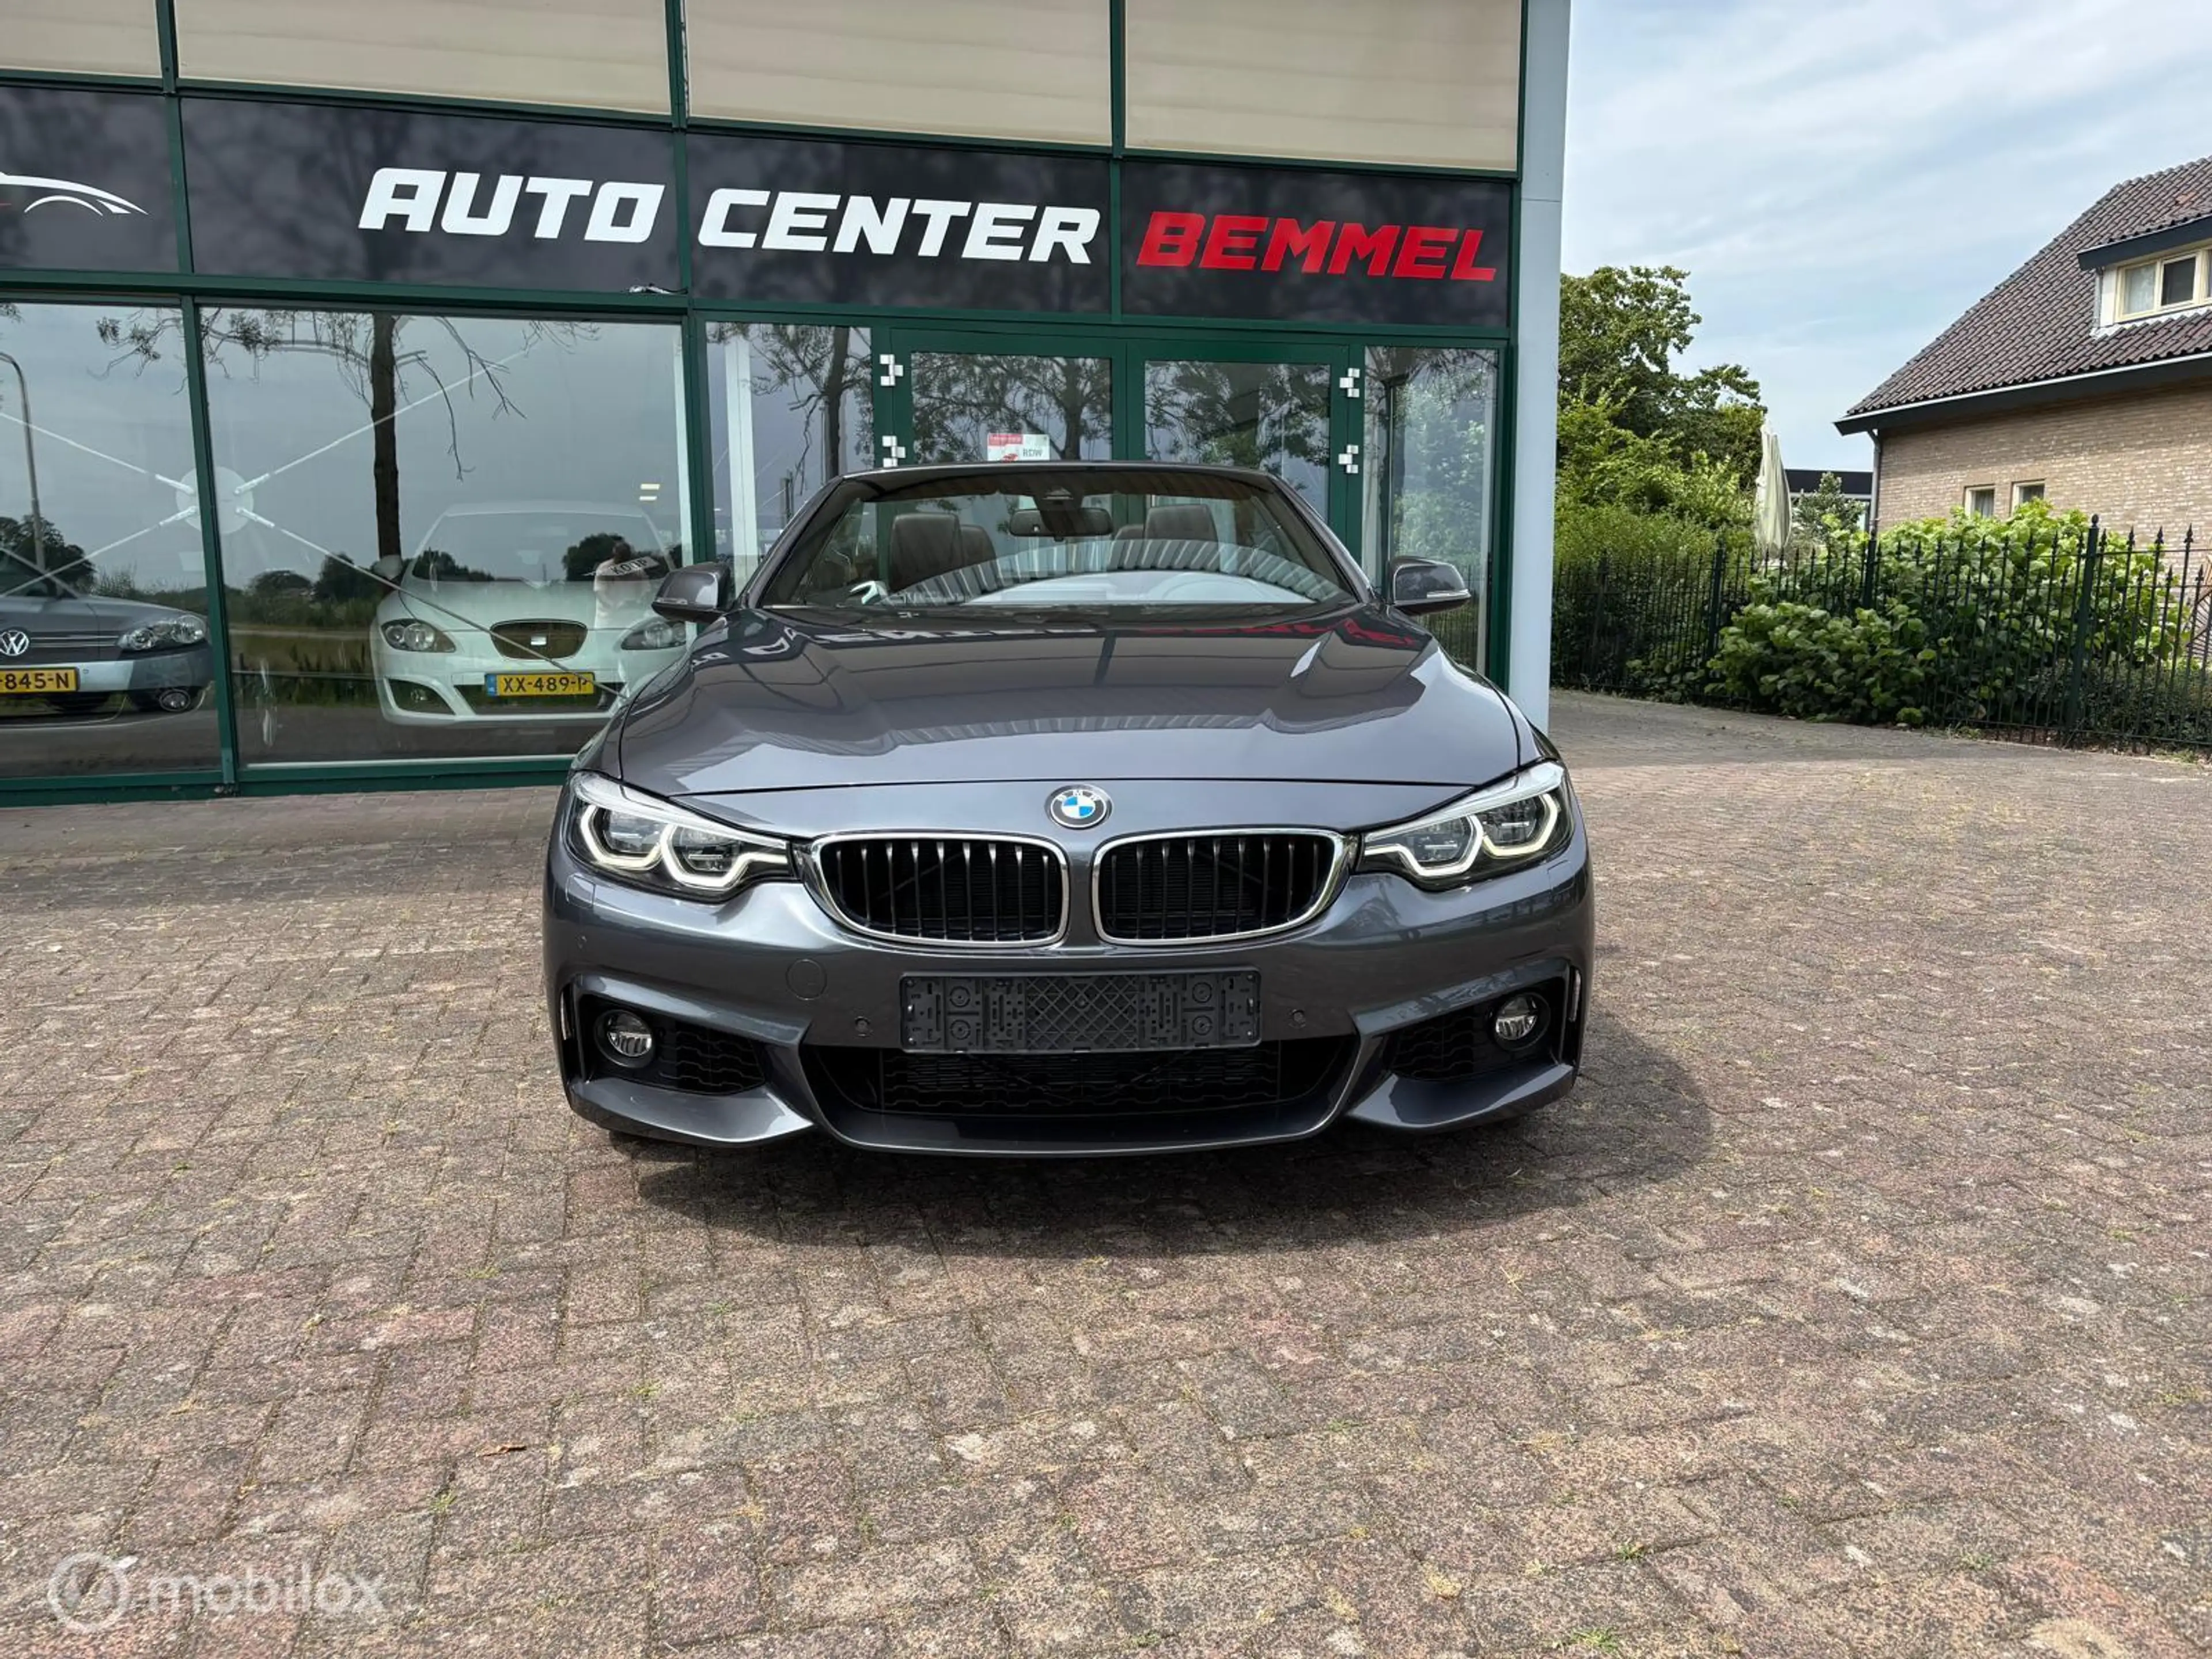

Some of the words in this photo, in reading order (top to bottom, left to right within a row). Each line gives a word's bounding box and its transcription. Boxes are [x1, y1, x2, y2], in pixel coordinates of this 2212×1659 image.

[358, 167, 665, 243] AUTO
[698, 188, 1100, 264] CENTER
[1137, 211, 1496, 281] BEMMEL
[503, 677, 588, 692] XX-489-P
[1056, 789, 1101, 801] BMW
